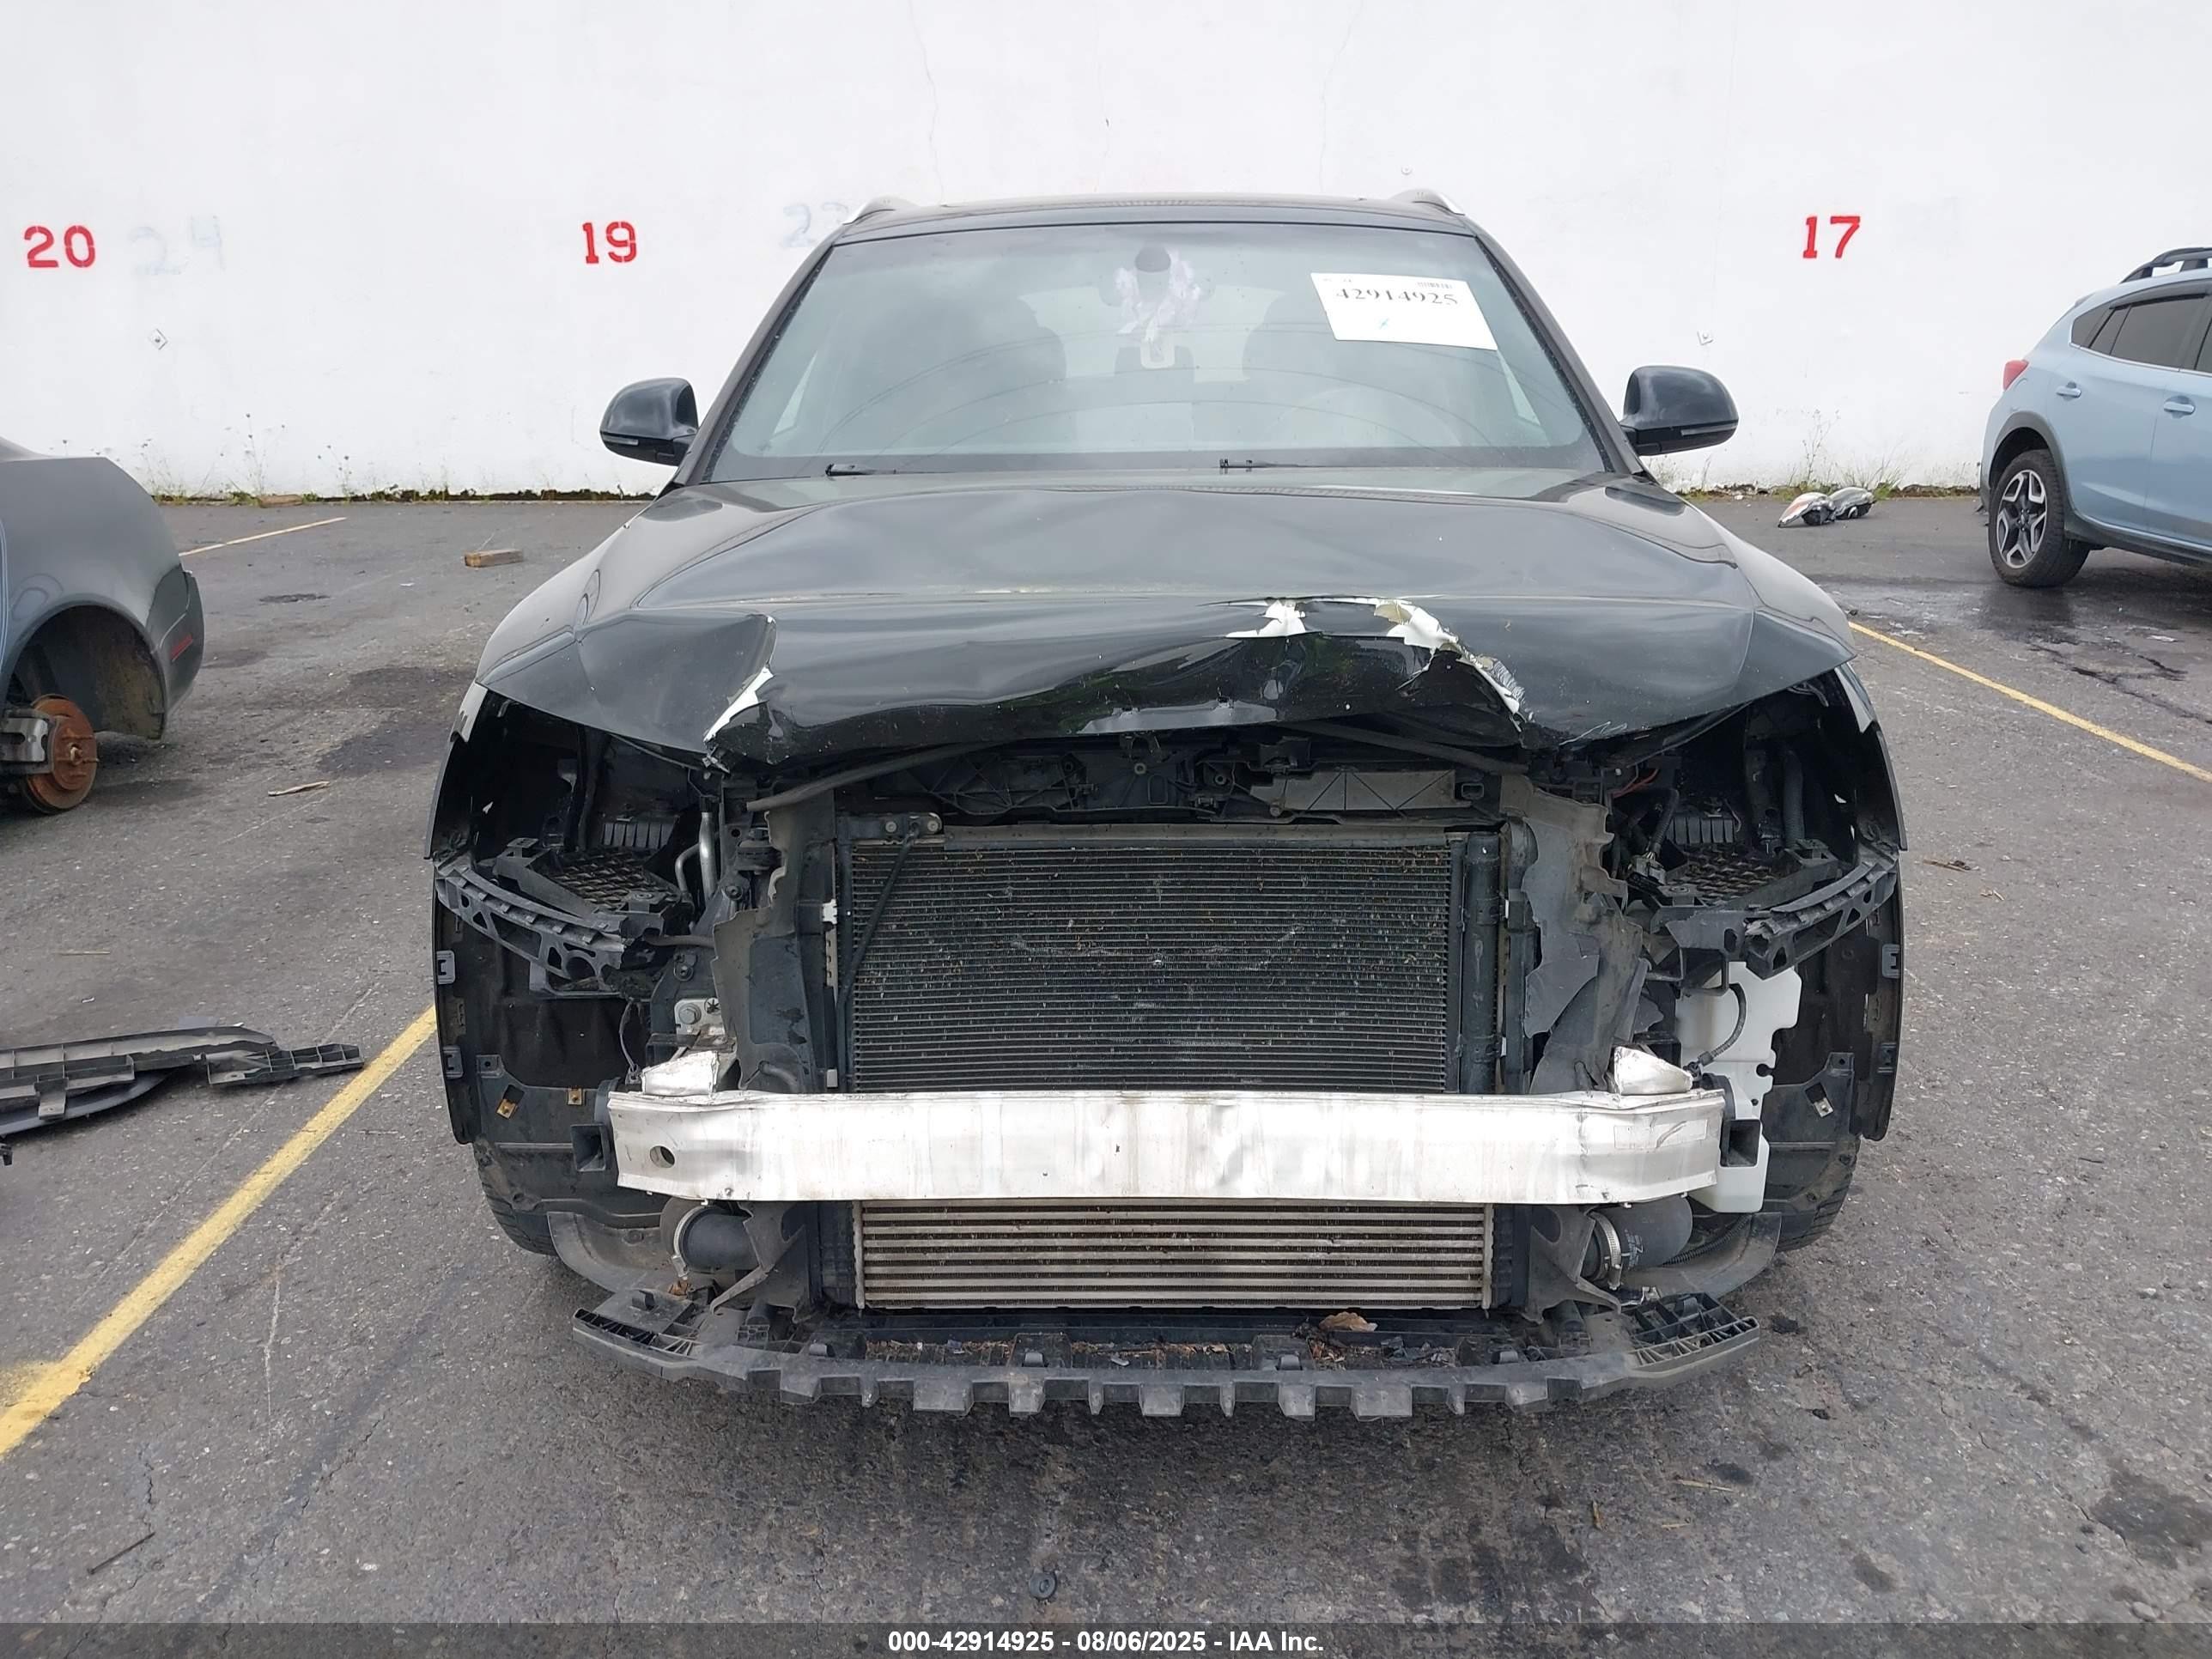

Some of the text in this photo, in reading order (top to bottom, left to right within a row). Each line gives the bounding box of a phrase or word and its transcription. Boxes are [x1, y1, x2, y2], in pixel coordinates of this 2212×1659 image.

[24, 225, 96, 269] 20
[581, 221, 638, 264] 19
[1802, 215, 1861, 259] 17
[1336, 288, 1459, 305] 42914925
